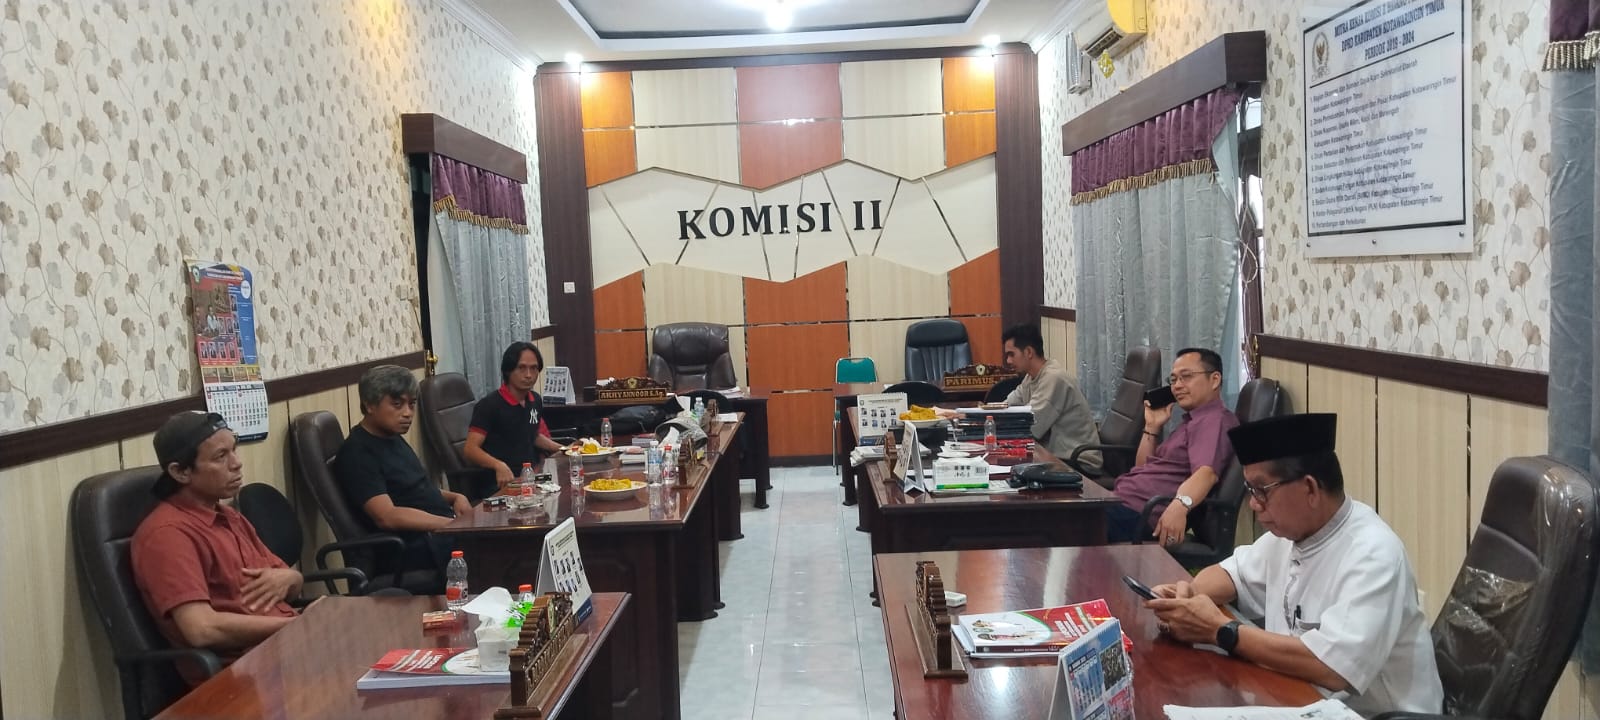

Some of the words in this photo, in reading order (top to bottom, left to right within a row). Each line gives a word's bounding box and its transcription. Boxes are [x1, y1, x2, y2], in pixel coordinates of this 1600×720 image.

[1341, 36, 1353, 51] DPRD
[1353, 24, 1381, 46] KABUPATEN
[1382, 5, 1423, 34] KOTAWARINGIN
[1425, 0, 1444, 16] TIMUR
[1364, 42, 1385, 60] PERIODE
[677, 202, 832, 240] KOMISI
[852, 200, 883, 231] II
